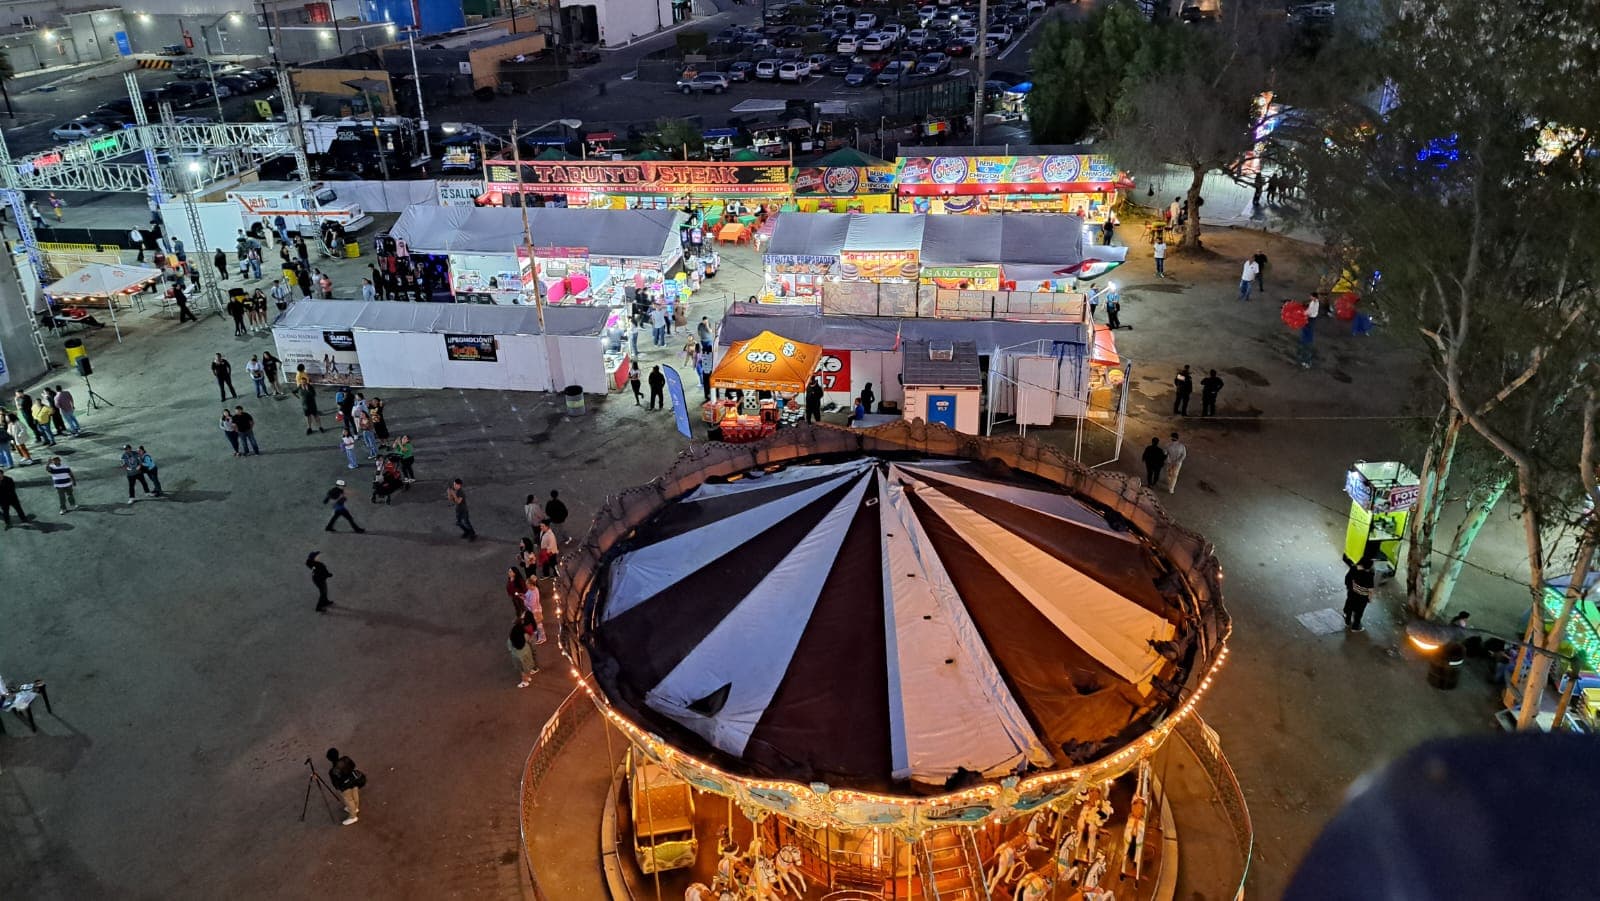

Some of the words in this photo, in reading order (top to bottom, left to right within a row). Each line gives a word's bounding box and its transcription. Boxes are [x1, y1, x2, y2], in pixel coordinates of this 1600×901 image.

[535, 165, 640, 183] TAQUITO
[657, 166, 740, 184] STEAK
[449, 188, 480, 199] SALIDA
[249, 198, 265, 209] DELTA
[771, 255, 794, 265] FRUTAS
[925, 267, 993, 278] SANACIÓN
[748, 363, 773, 374] 91.7
[814, 355, 842, 373] xa
